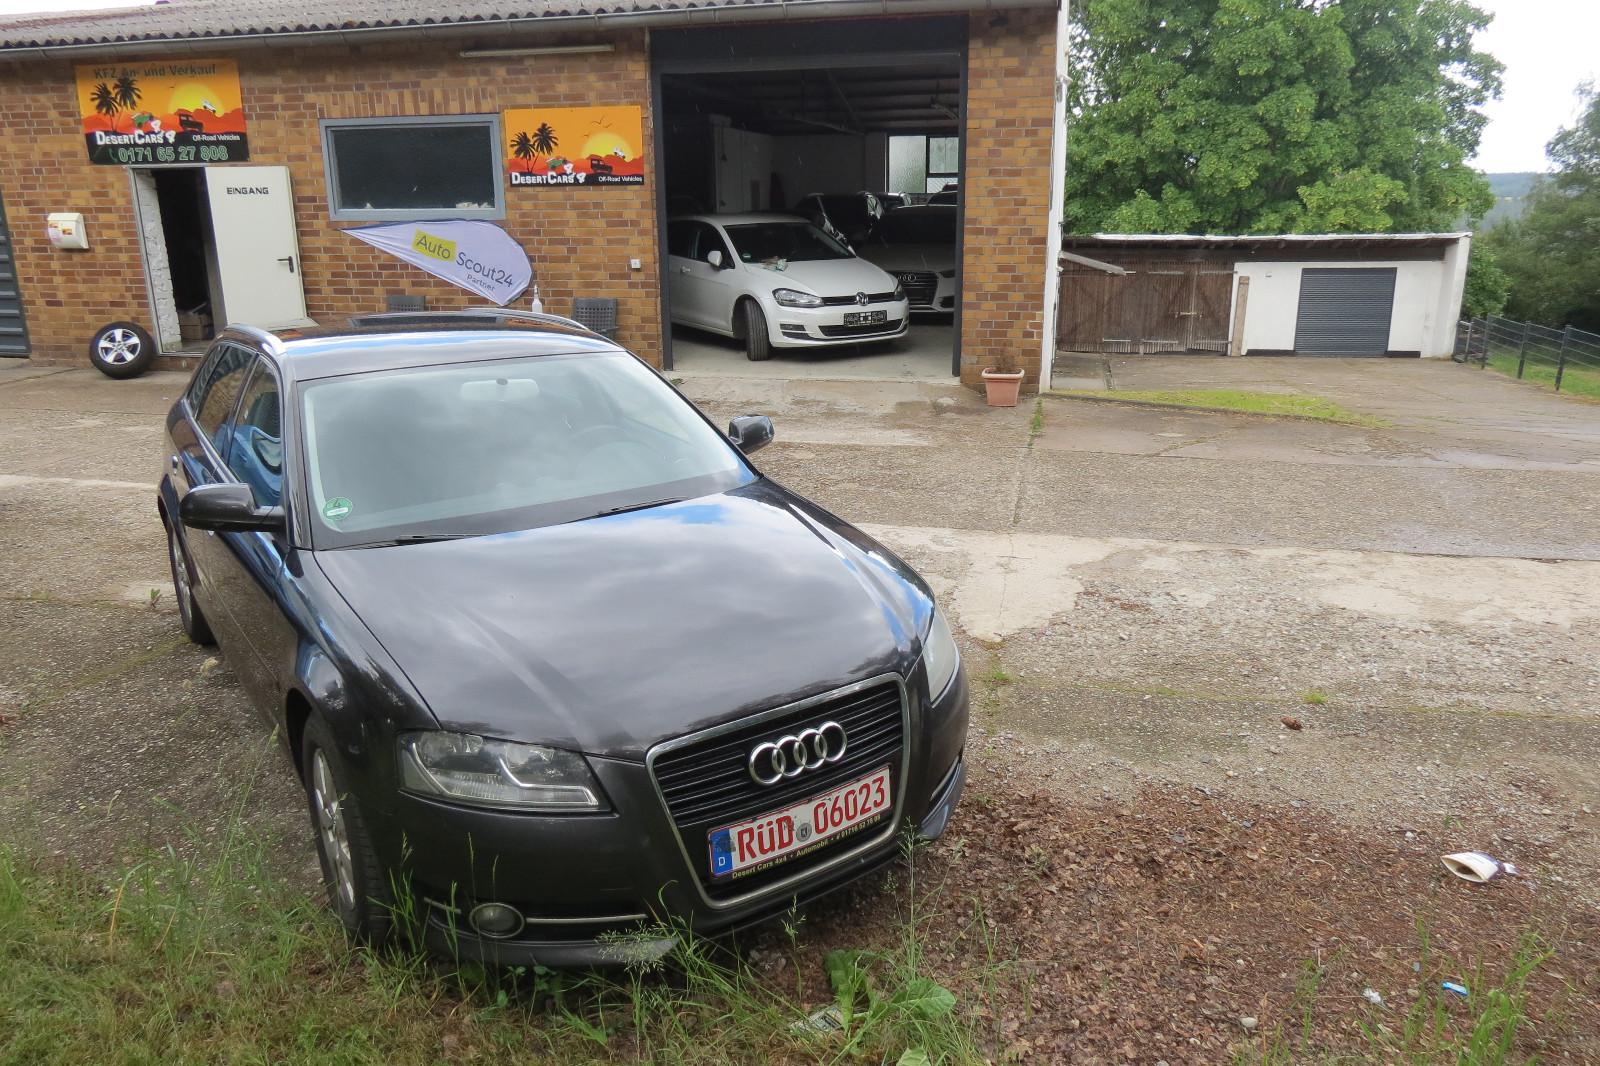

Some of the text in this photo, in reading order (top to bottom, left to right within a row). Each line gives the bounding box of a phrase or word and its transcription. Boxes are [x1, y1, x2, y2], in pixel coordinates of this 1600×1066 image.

[144, 66, 165, 77] und
[168, 64, 216, 76] Verkauf
[118, 145, 228, 162] 0171 65 27 808
[226, 187, 269, 195] EINGANG
[415, 235, 513, 288] Auto Scout24
[466, 272, 496, 292] partner
[813, 775, 885, 835] 06023
[718, 856, 726, 867] D
[732, 866, 756, 879] Desert
[757, 861, 773, 871] Cars
